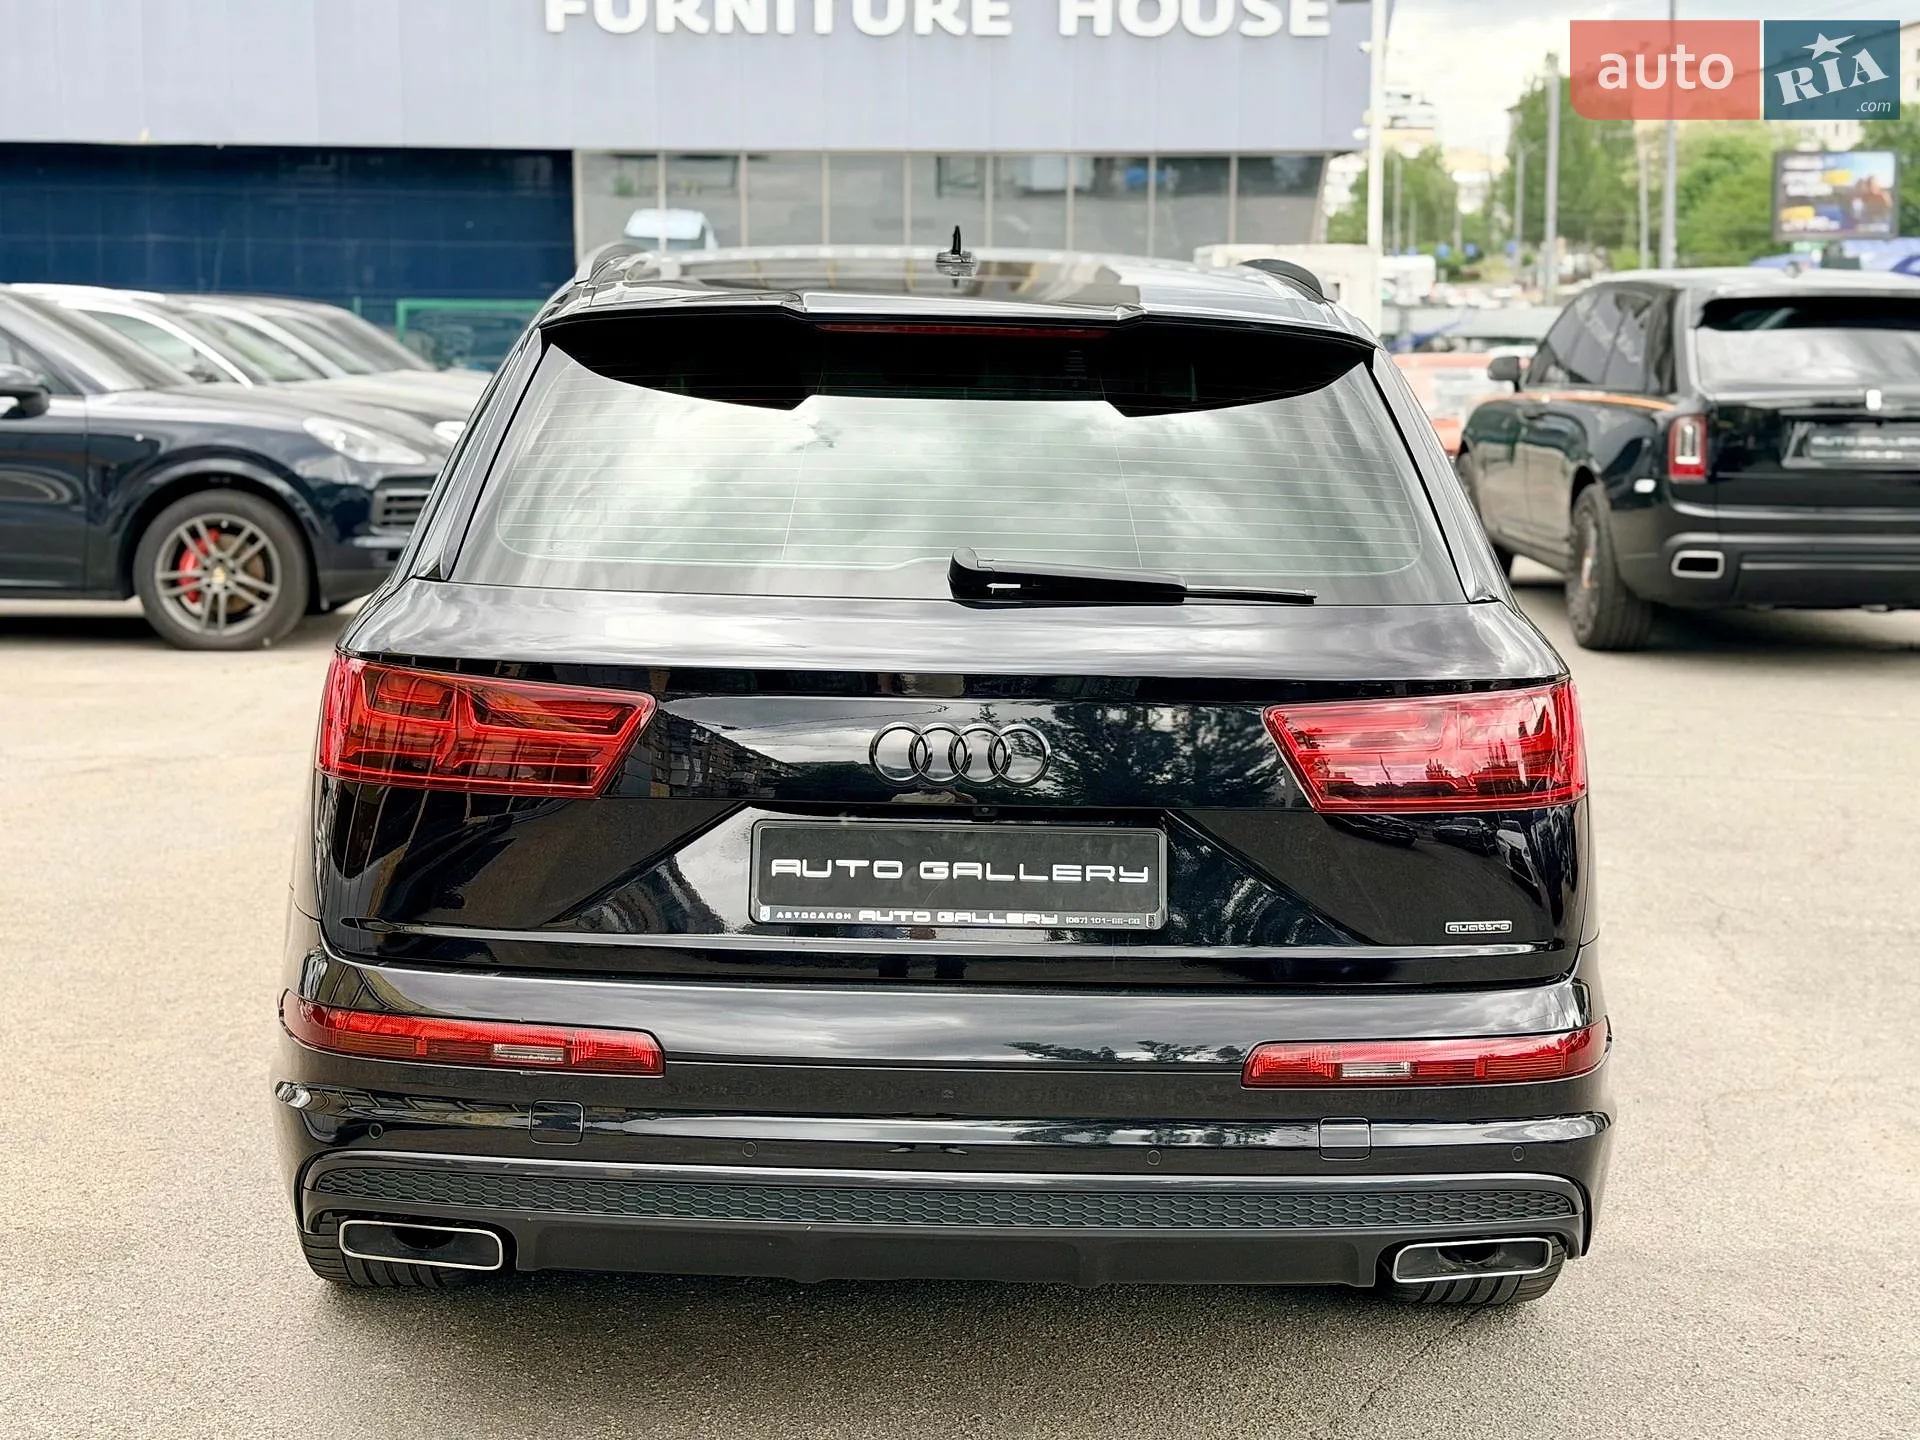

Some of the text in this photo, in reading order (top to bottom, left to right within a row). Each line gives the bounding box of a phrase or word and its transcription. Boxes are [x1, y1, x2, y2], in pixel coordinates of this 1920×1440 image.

[1058, 0, 1331, 37] HOUSE
[771, 859, 1150, 884] AUTO GALLERY
[858, 910, 931, 922] AUTO
[936, 911, 1058, 925] GALLERY
[1449, 924, 1509, 932] quattro
